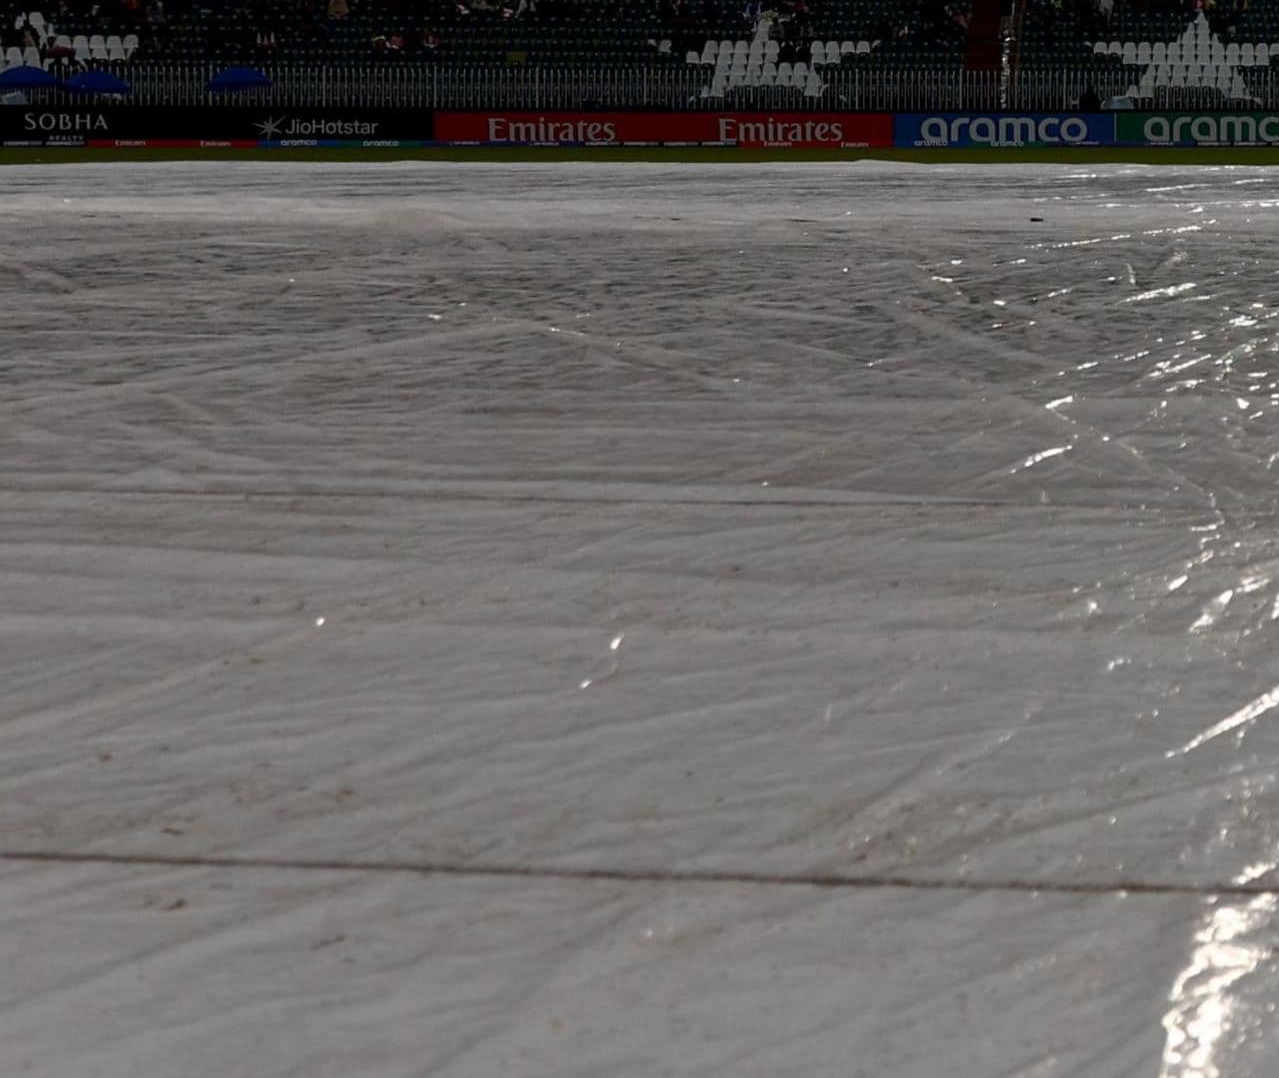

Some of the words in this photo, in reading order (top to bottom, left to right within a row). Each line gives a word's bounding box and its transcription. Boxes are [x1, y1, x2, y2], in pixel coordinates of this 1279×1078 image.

[24, 113, 109, 131] SOBHA
[285, 120, 378, 135] JioHotstar
[487, 117, 616, 142] Emirates
[718, 117, 843, 142] Emirates
[920, 117, 1088, 142] aramco
